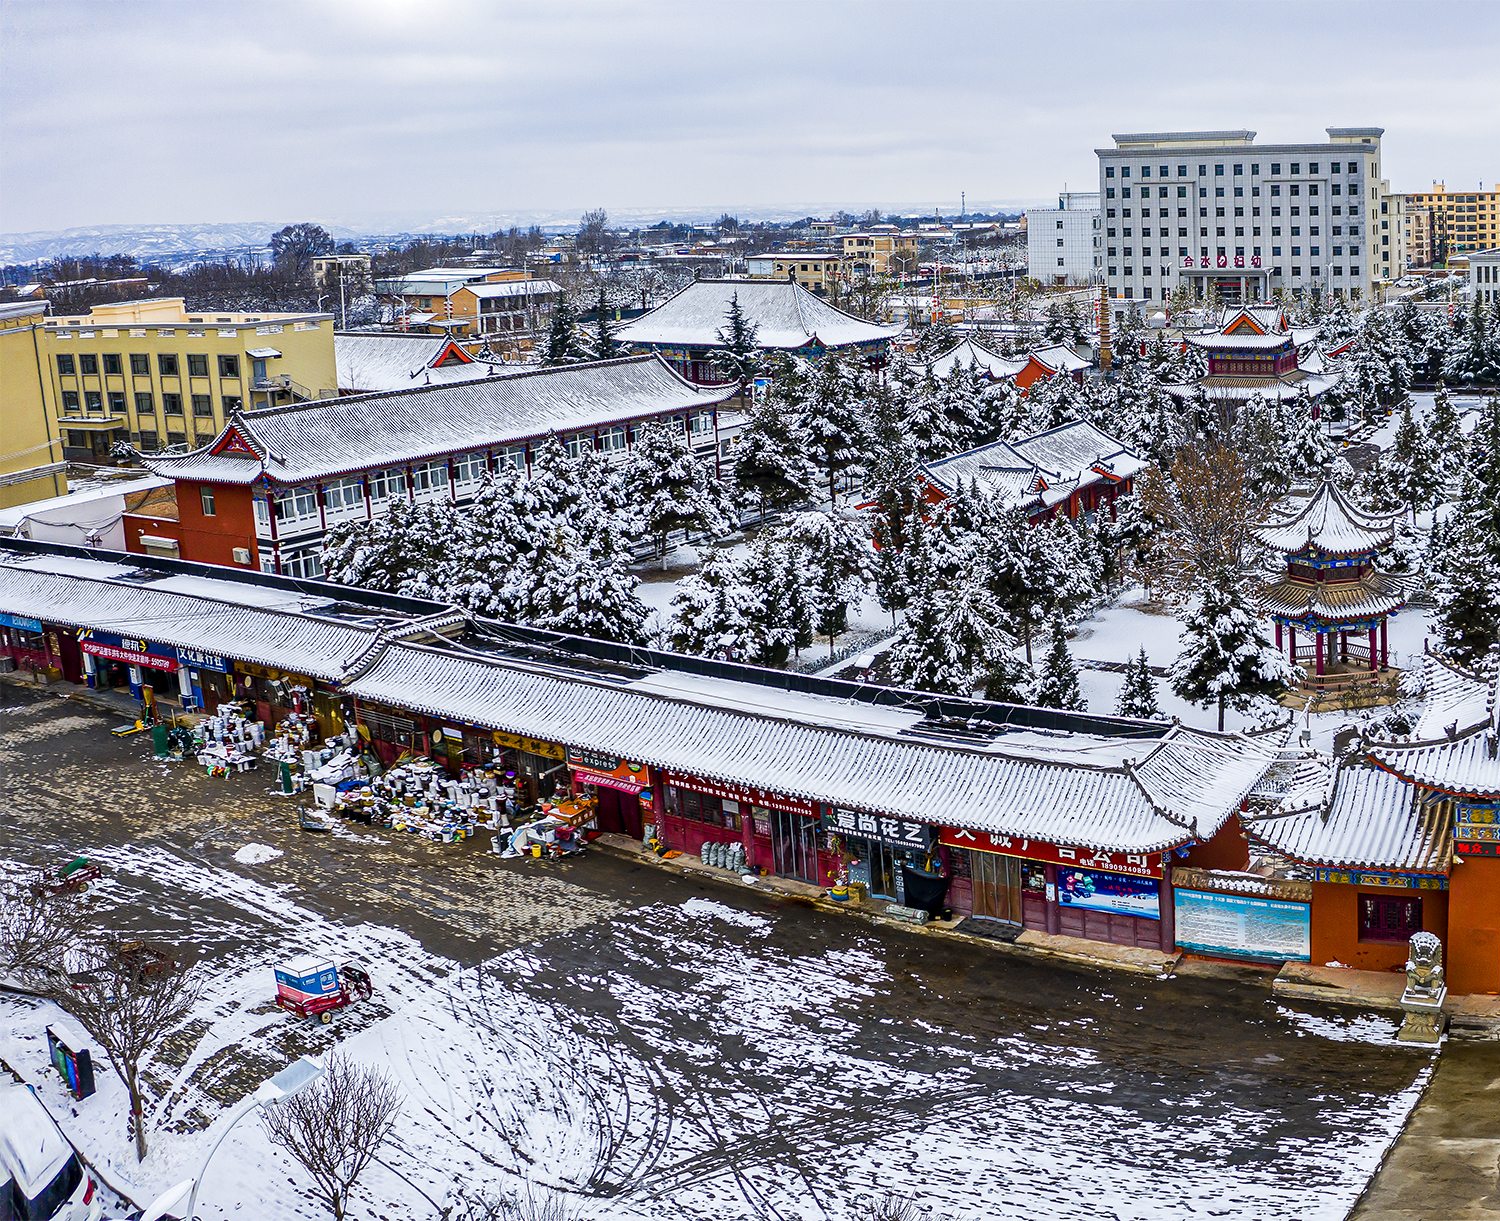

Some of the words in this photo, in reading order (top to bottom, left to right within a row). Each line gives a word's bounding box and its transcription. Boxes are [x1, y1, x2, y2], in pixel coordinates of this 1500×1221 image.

[1184, 255, 1211, 267] 合水
[1234, 255, 1261, 267] 妇幼
[584, 756, 617, 770] express
[837, 808, 923, 843] 爱尚花艺
